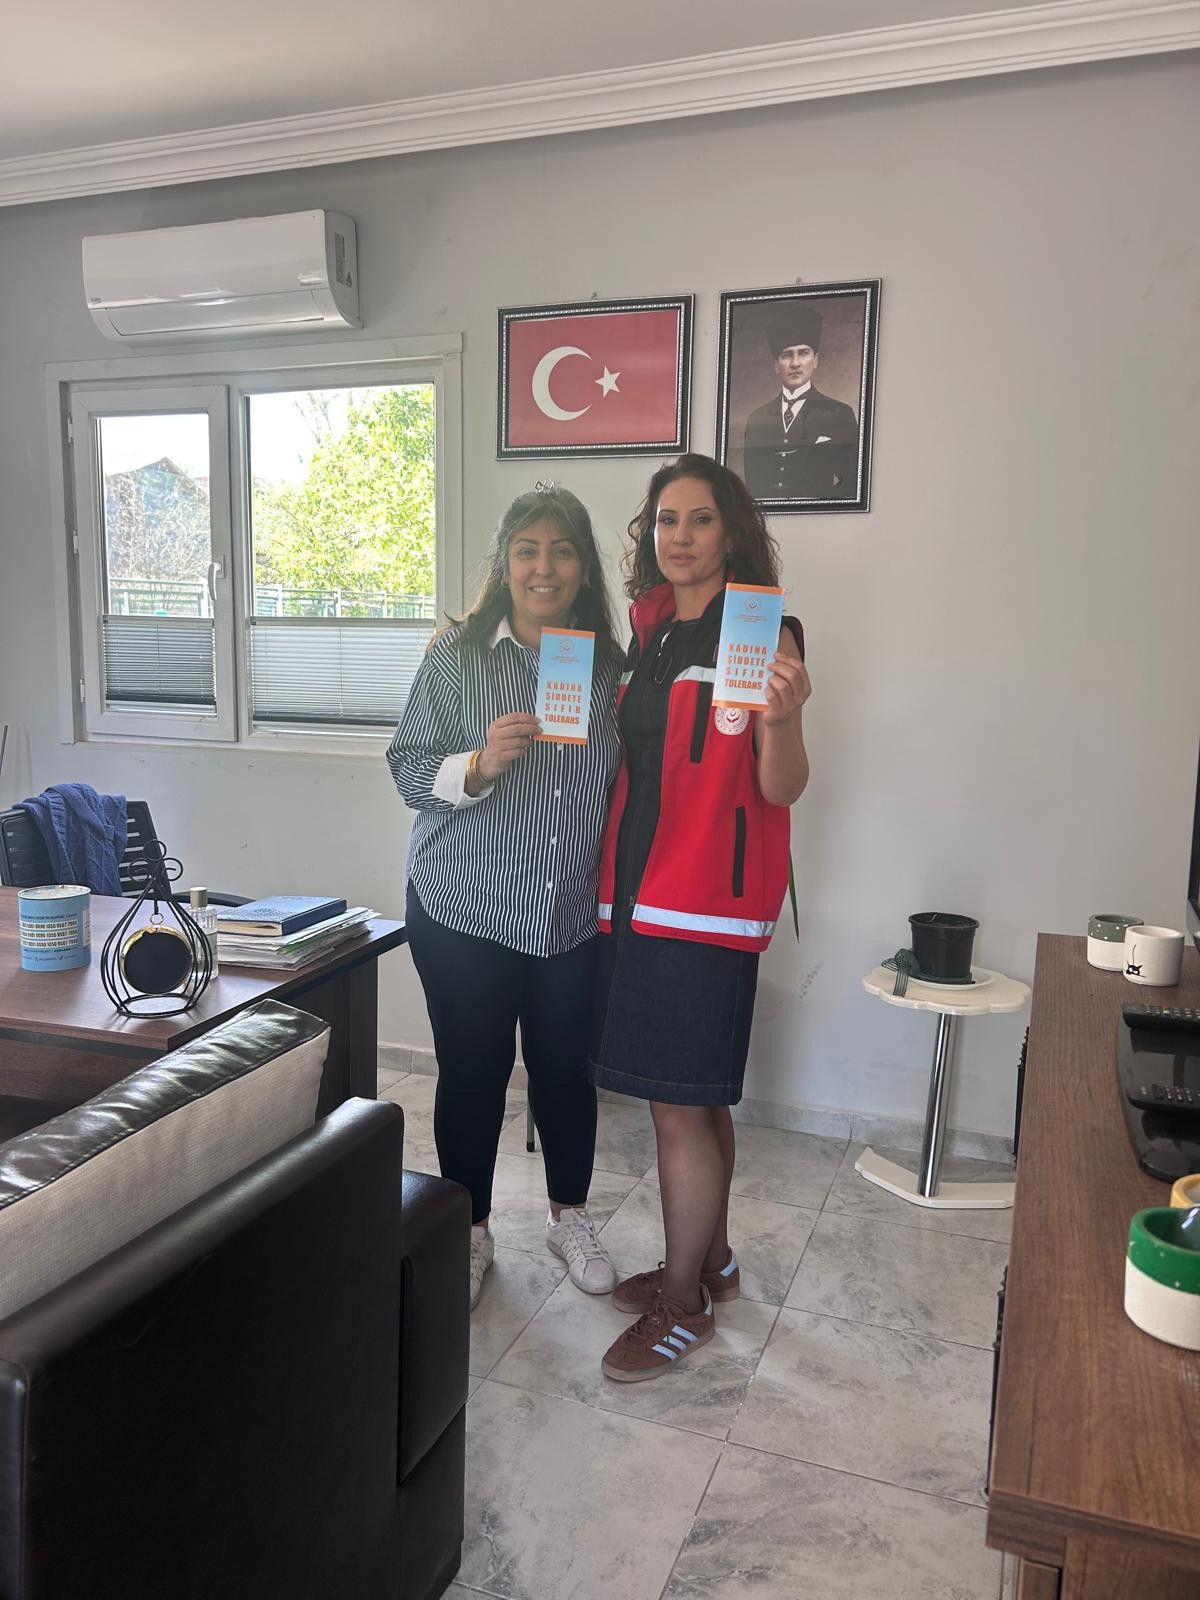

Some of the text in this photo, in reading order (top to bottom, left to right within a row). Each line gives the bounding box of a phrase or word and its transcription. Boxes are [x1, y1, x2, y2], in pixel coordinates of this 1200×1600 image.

[727, 643, 767, 656] KADINA
[725, 667, 765, 678] SIFIR
[545, 680, 582, 692] KADINA
[724, 678, 763, 690] TOLERANS
[544, 702, 581, 714] SIFIR
[544, 713, 580, 725] TOLERANS
